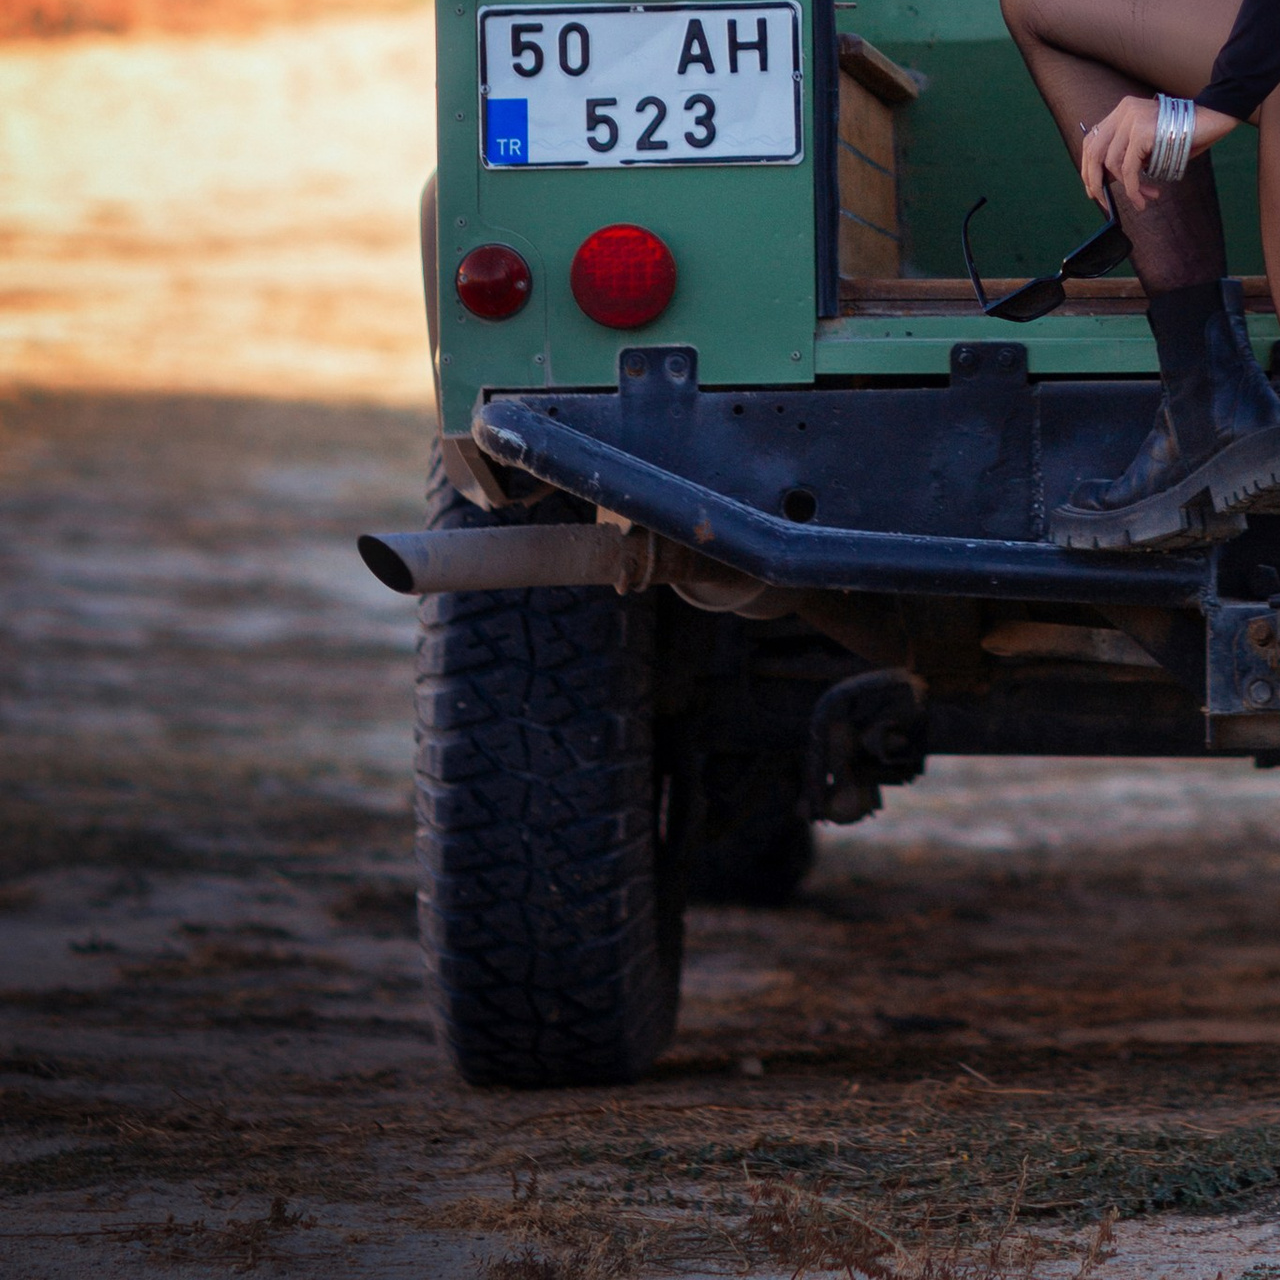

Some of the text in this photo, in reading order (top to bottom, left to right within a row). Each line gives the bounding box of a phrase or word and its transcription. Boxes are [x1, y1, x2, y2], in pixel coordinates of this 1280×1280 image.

[511, 17, 768, 77] 50 AH
[496, 139, 521, 156] TR
[586, 93, 716, 152] 523
